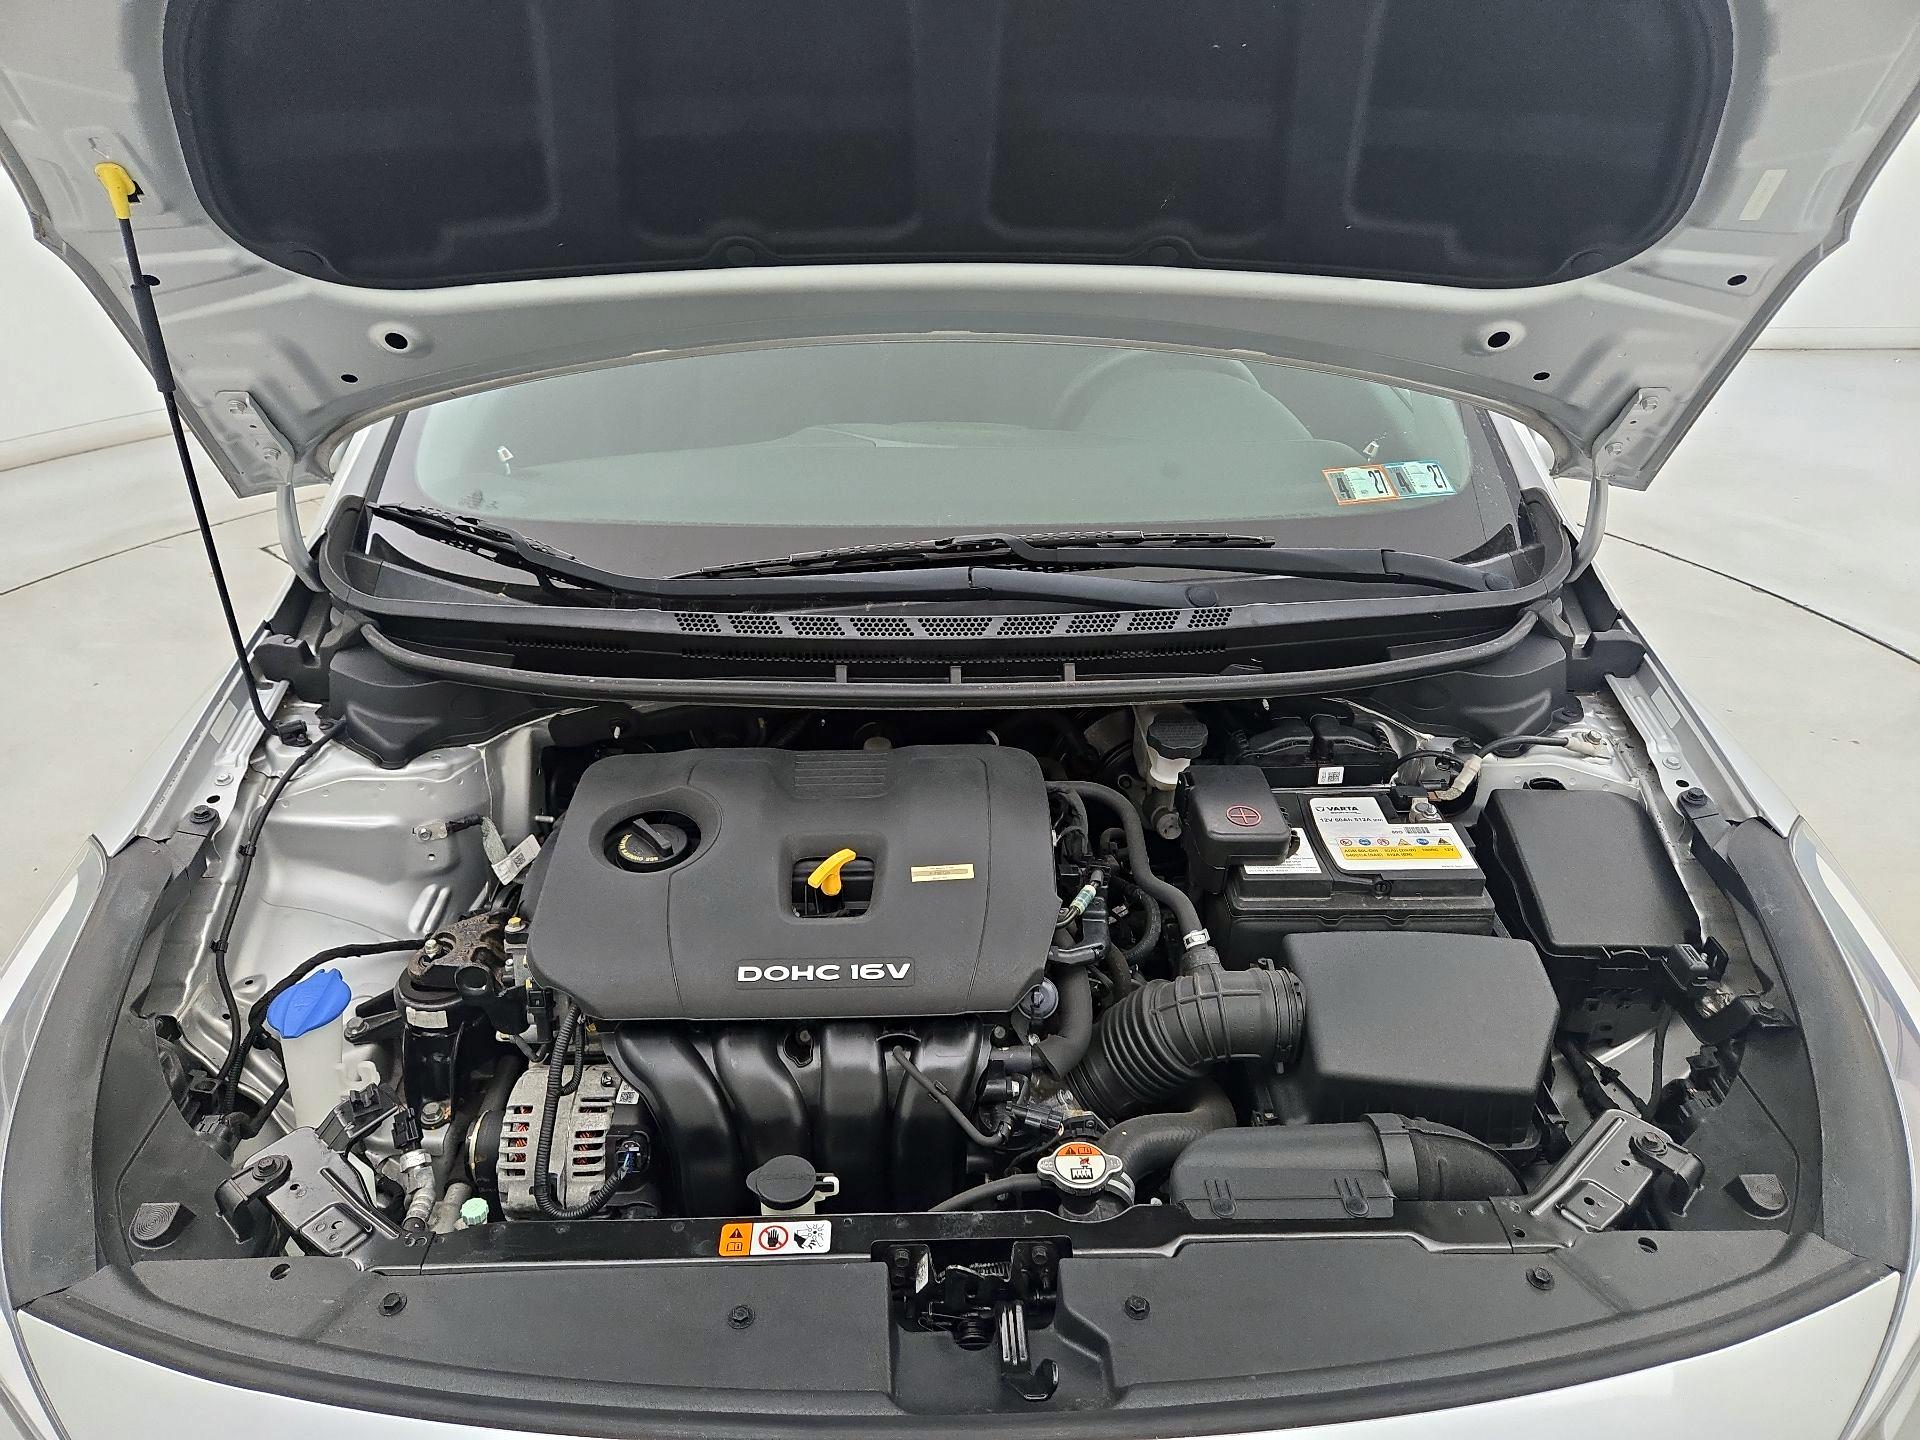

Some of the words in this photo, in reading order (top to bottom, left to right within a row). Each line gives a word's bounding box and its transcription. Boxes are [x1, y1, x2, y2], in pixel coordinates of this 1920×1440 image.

[1368, 469, 1390, 495] 27
[1427, 464, 1448, 489] 27
[737, 964, 841, 982] DOHC
[850, 963, 911, 980] 16V
